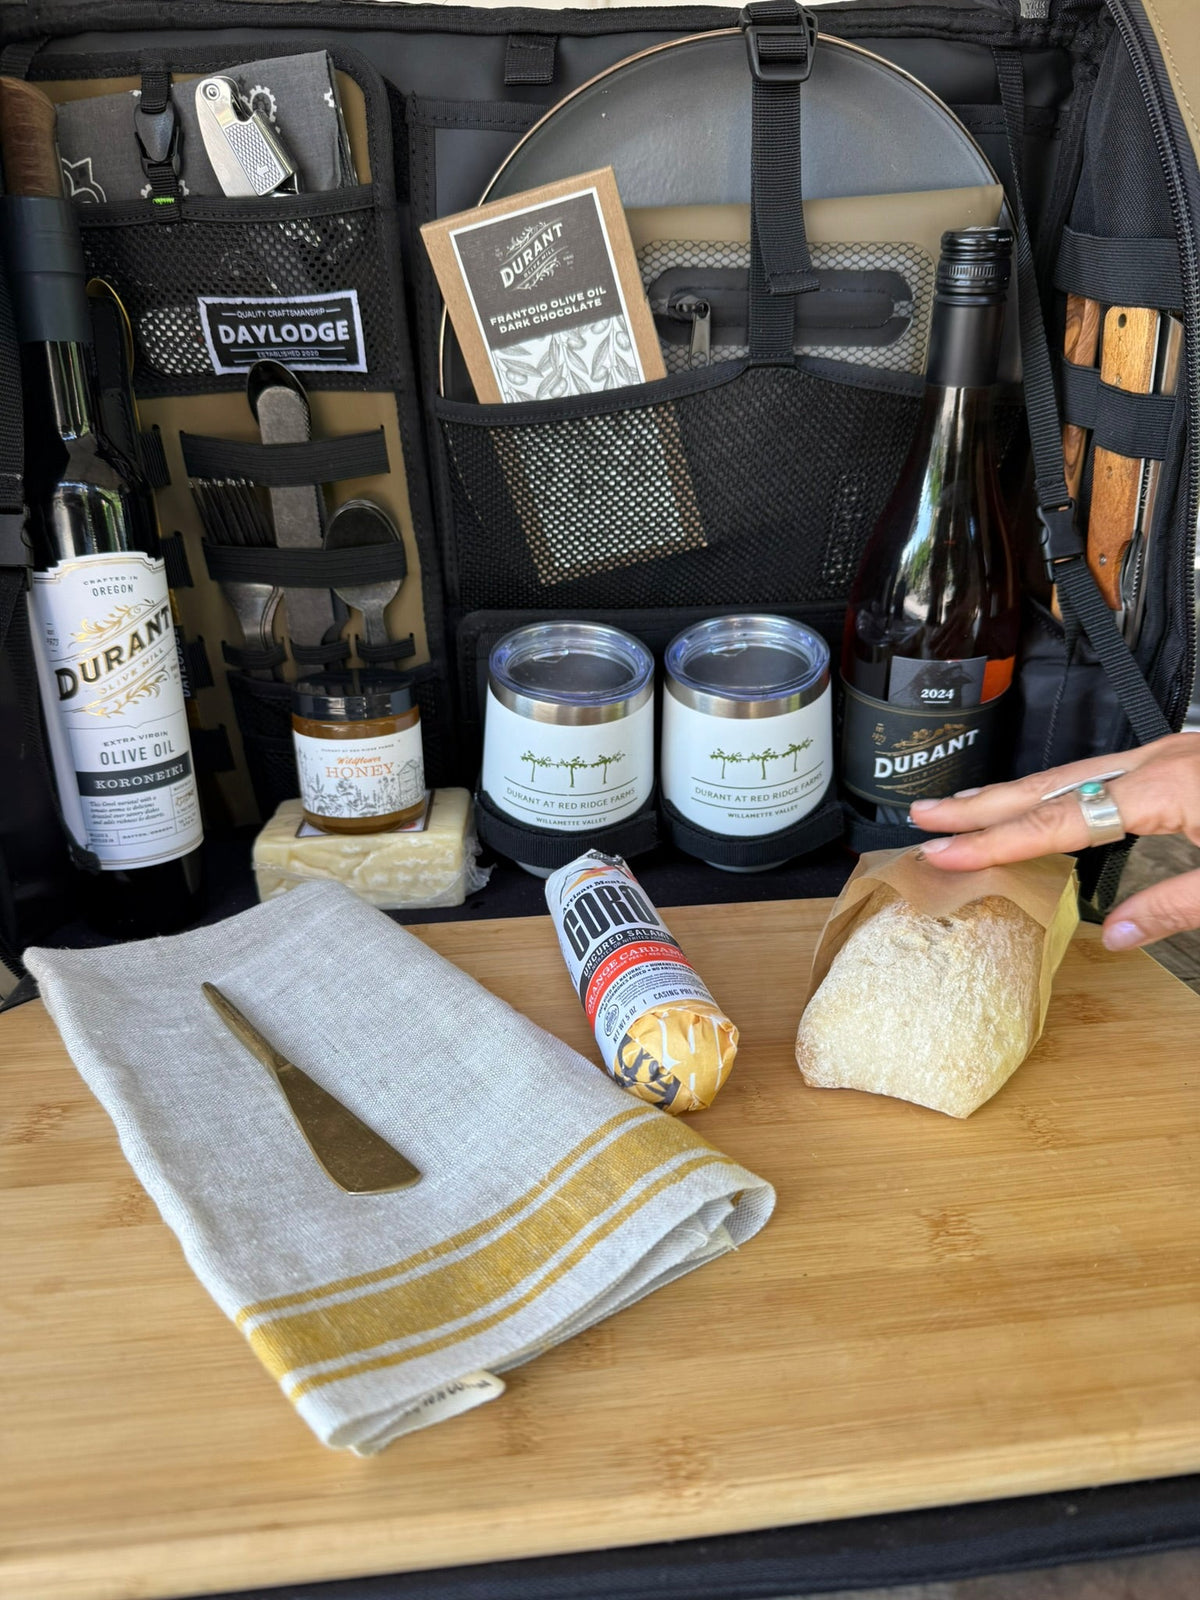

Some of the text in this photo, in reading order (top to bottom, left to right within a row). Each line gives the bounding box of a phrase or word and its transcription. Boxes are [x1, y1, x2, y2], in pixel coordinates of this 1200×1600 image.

[500, 222, 563, 288] DURANT
[541, 248, 555, 260] MILL
[236, 308, 325, 319] QUALITY CRAFTSMANSHIP
[490, 287, 607, 326] FRANTOIO OLIVE OIL
[499, 298, 602, 334] DARK CHOCOLATE
[218, 320, 350, 344] DAYLODGE
[256, 350, 301, 358] ESTABLISHED
[83, 576, 126, 585] CRAFTED
[92, 584, 134, 597] OREGON
[55, 604, 171, 701] DURANT
[920, 688, 955, 699] 2024
[103, 731, 168, 747] EXTRA VIRGIN
[100, 740, 175, 766] OLIVE OIL
[873, 729, 979, 778] DURANT
[95, 764, 184, 789] KORONEIKI
[325, 761, 394, 780] HONEY
[506, 787, 636, 810] DURANT AT RED RIDGE FARMS
[695, 771, 822, 803] DURANT AT RED RIDGE FARMS
[536, 816, 607, 826] WILLAMETTE VALLEY
[727, 804, 799, 819] WILLAMETTE VALLEY
[563, 885, 661, 961] CORO
[583, 929, 670, 976] UNCURED SALAMI
[588, 959, 618, 1015] ORANGE
[653, 988, 680, 1000] CASING
[613, 1005, 638, 1043] NET WT 5 OZ
